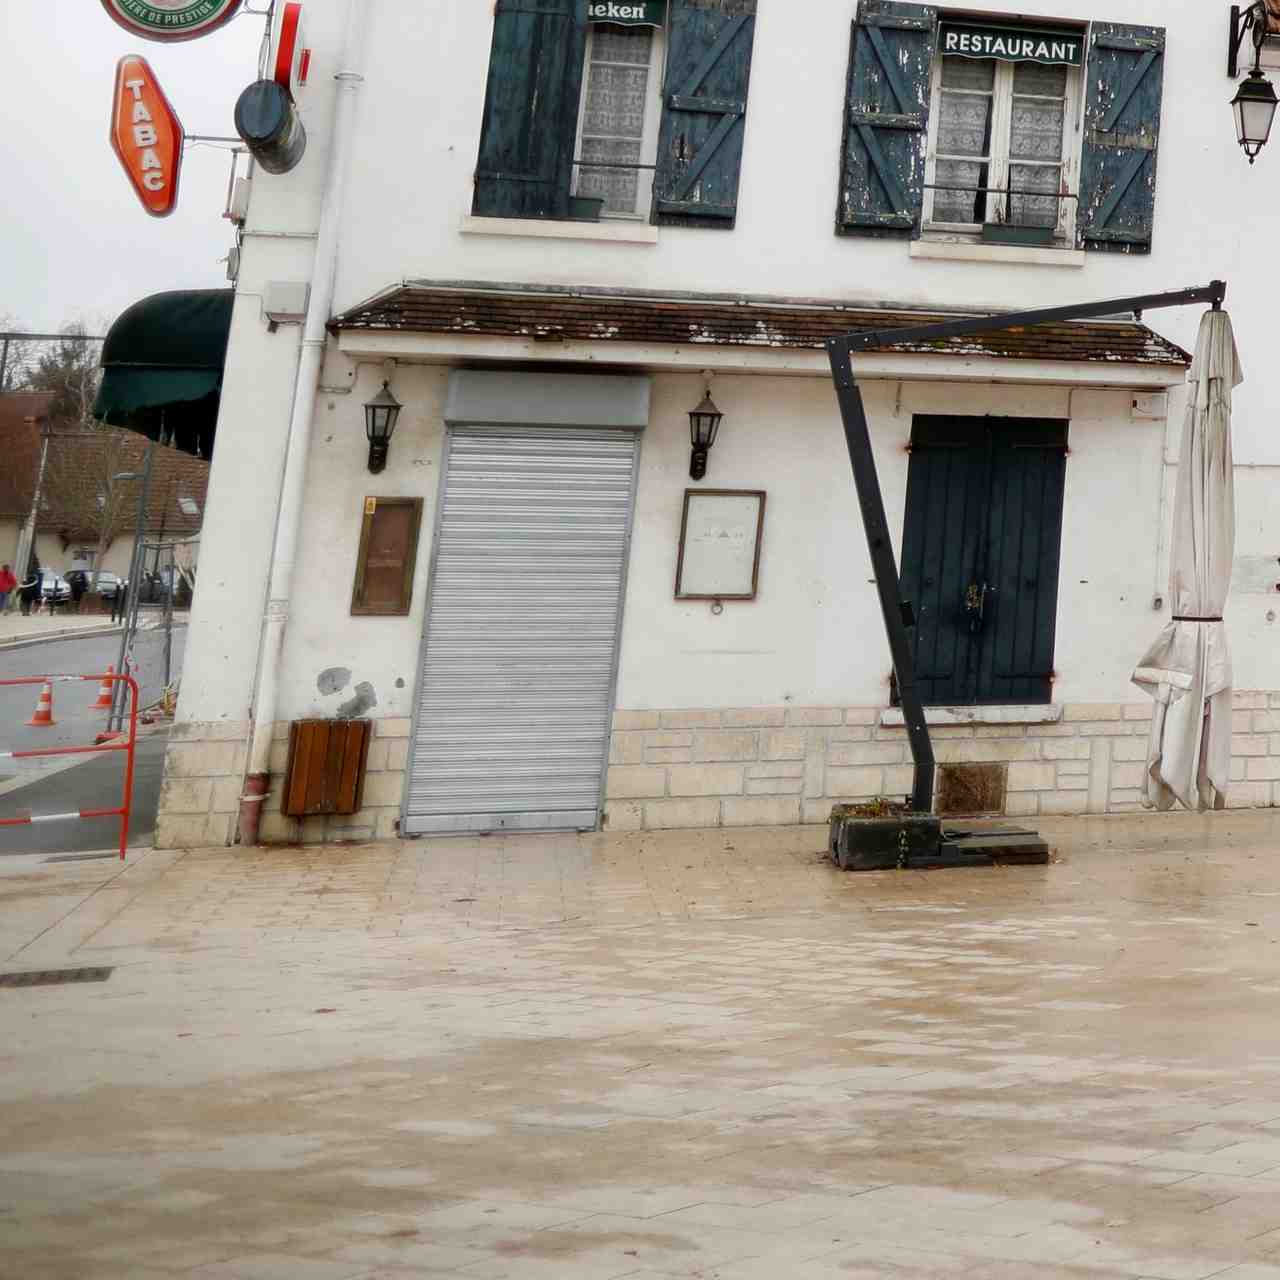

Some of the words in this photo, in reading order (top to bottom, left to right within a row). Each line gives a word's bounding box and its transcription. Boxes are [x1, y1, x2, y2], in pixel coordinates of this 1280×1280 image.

[147, 12, 163, 24] DE
[164, 1, 214, 25] PRESTIGE
[946, 32, 1077, 60] RESTAURANT
[125, 80, 167, 191] TABAC
